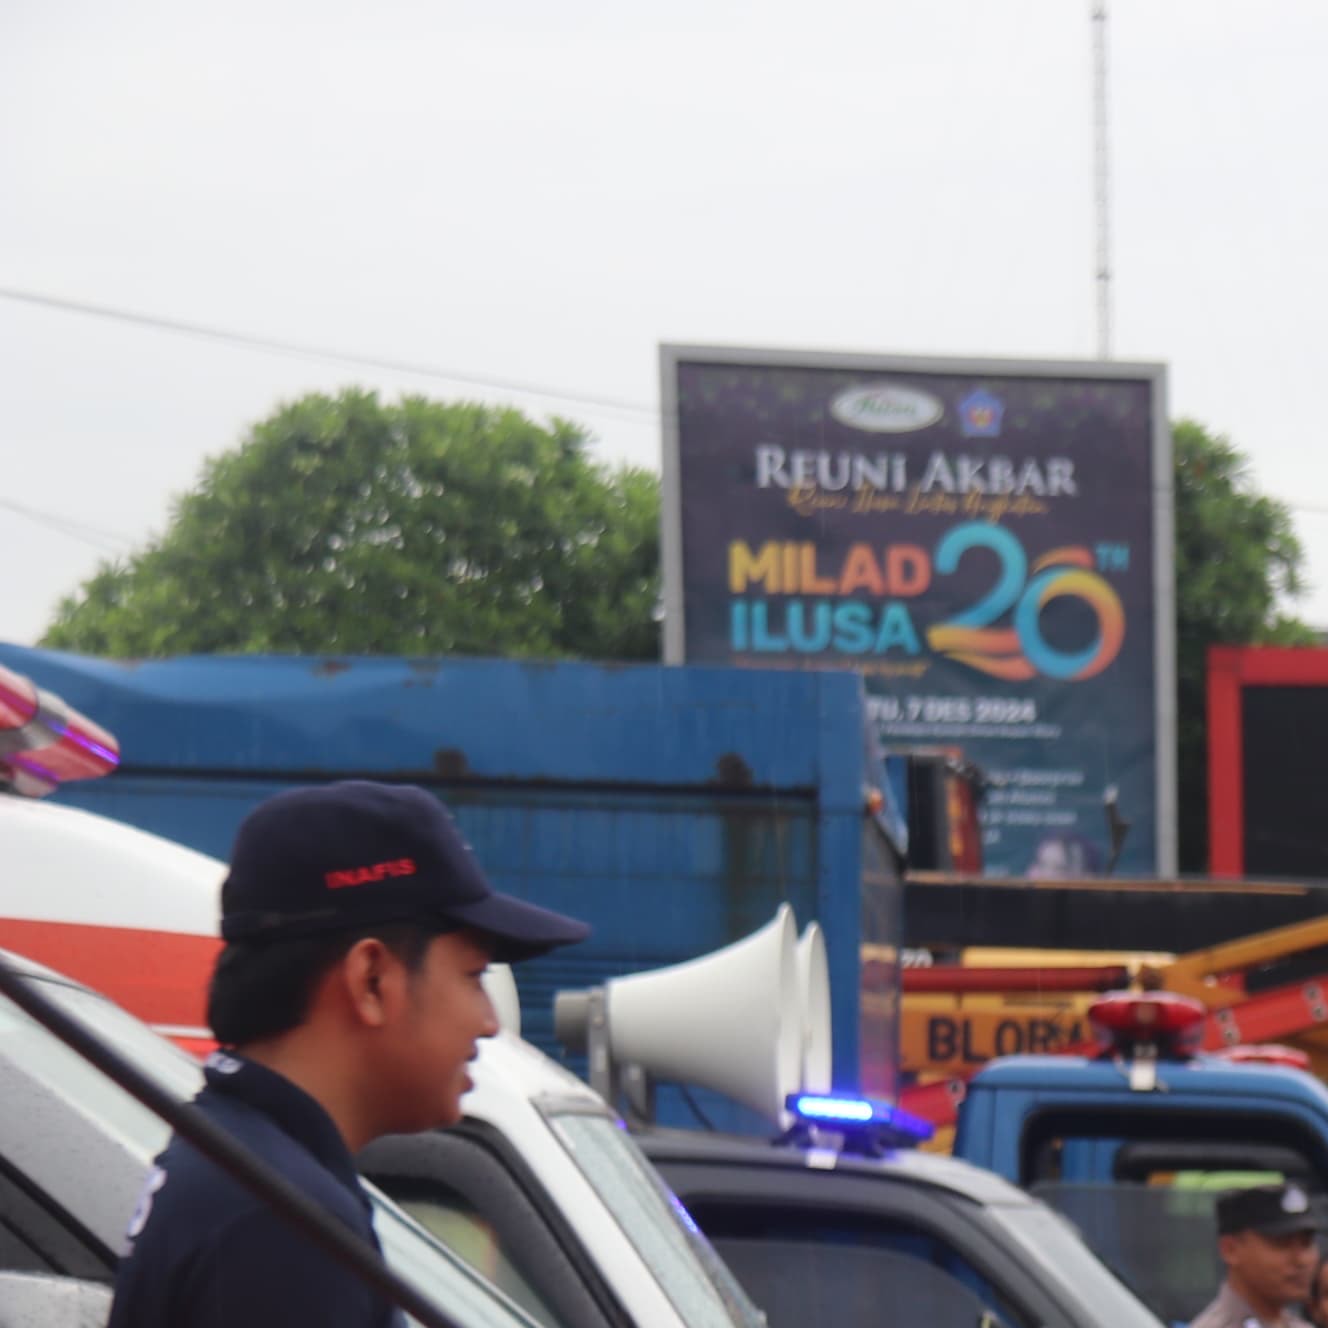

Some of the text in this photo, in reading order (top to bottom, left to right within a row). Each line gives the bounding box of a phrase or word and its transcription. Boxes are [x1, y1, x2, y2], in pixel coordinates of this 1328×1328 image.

[756, 444, 1079, 497] REUNI AKBAR
[728, 541, 932, 596] MILAD
[731, 599, 922, 655] ILUSA
[975, 700, 1036, 722] 2024
[325, 857, 417, 890] INAFIS
[928, 1014, 1088, 1063] BLORA
